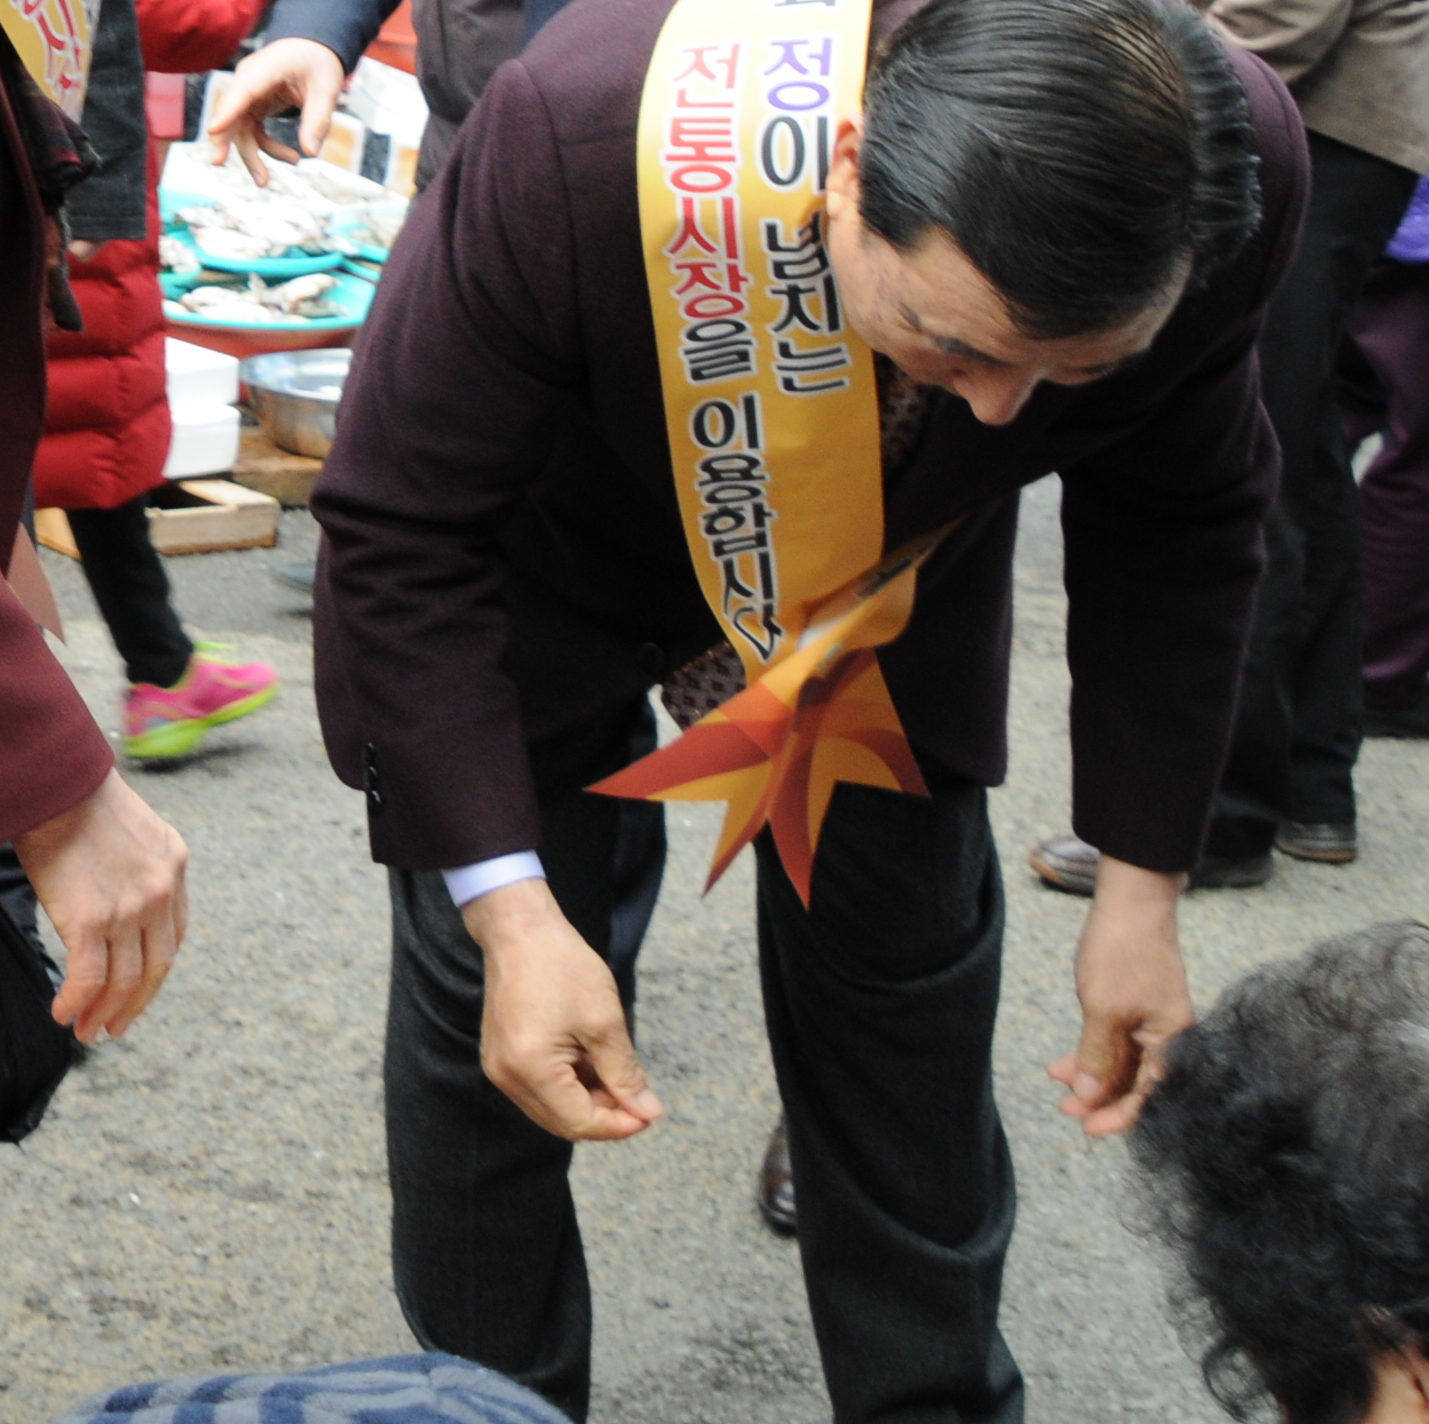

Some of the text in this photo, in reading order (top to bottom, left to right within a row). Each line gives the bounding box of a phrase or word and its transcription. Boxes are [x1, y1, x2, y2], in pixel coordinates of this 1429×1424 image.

[761, 40, 832, 187] 정이
[665, 44, 782, 660] 전통시장을 이용합시다
[765, 220, 849, 393] 넘치는
